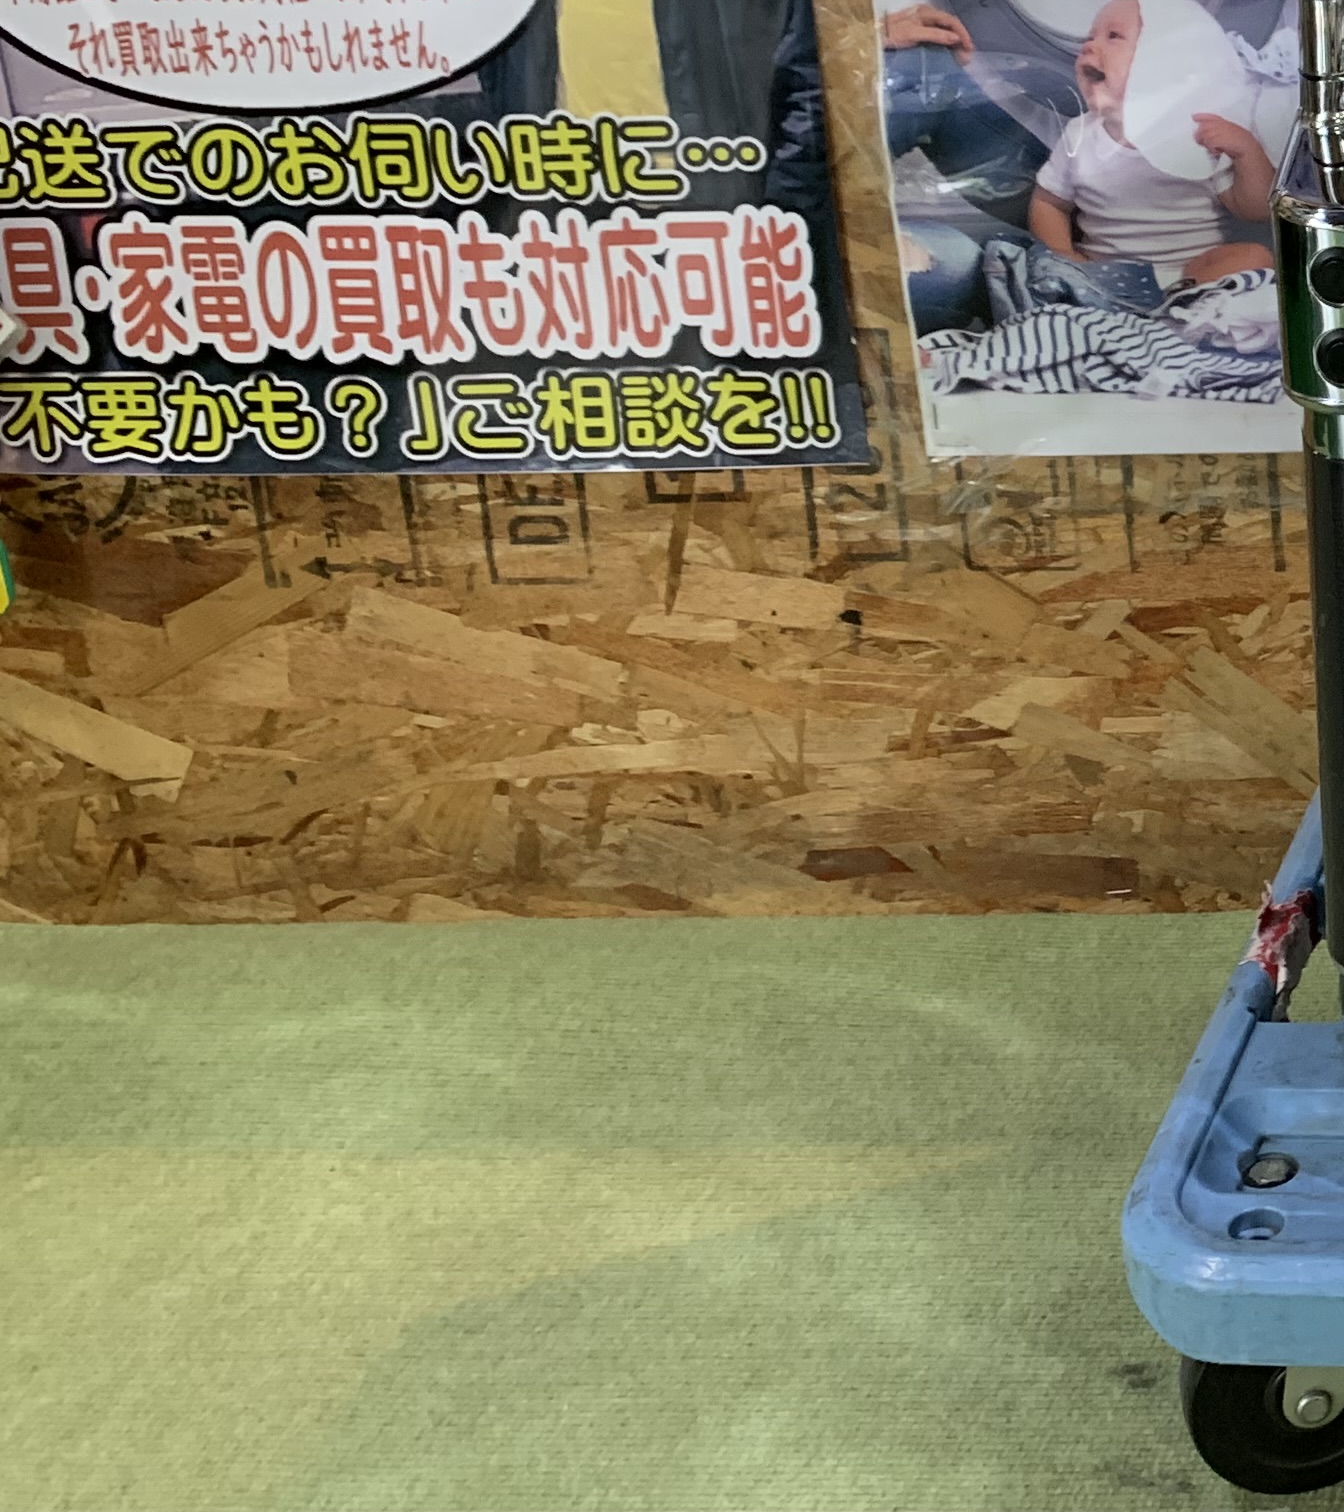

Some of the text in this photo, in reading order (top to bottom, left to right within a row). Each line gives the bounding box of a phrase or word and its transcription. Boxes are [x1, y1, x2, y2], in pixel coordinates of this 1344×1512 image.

[67, 17, 450, 77] それ買取出来ちゃうかもしれません。
